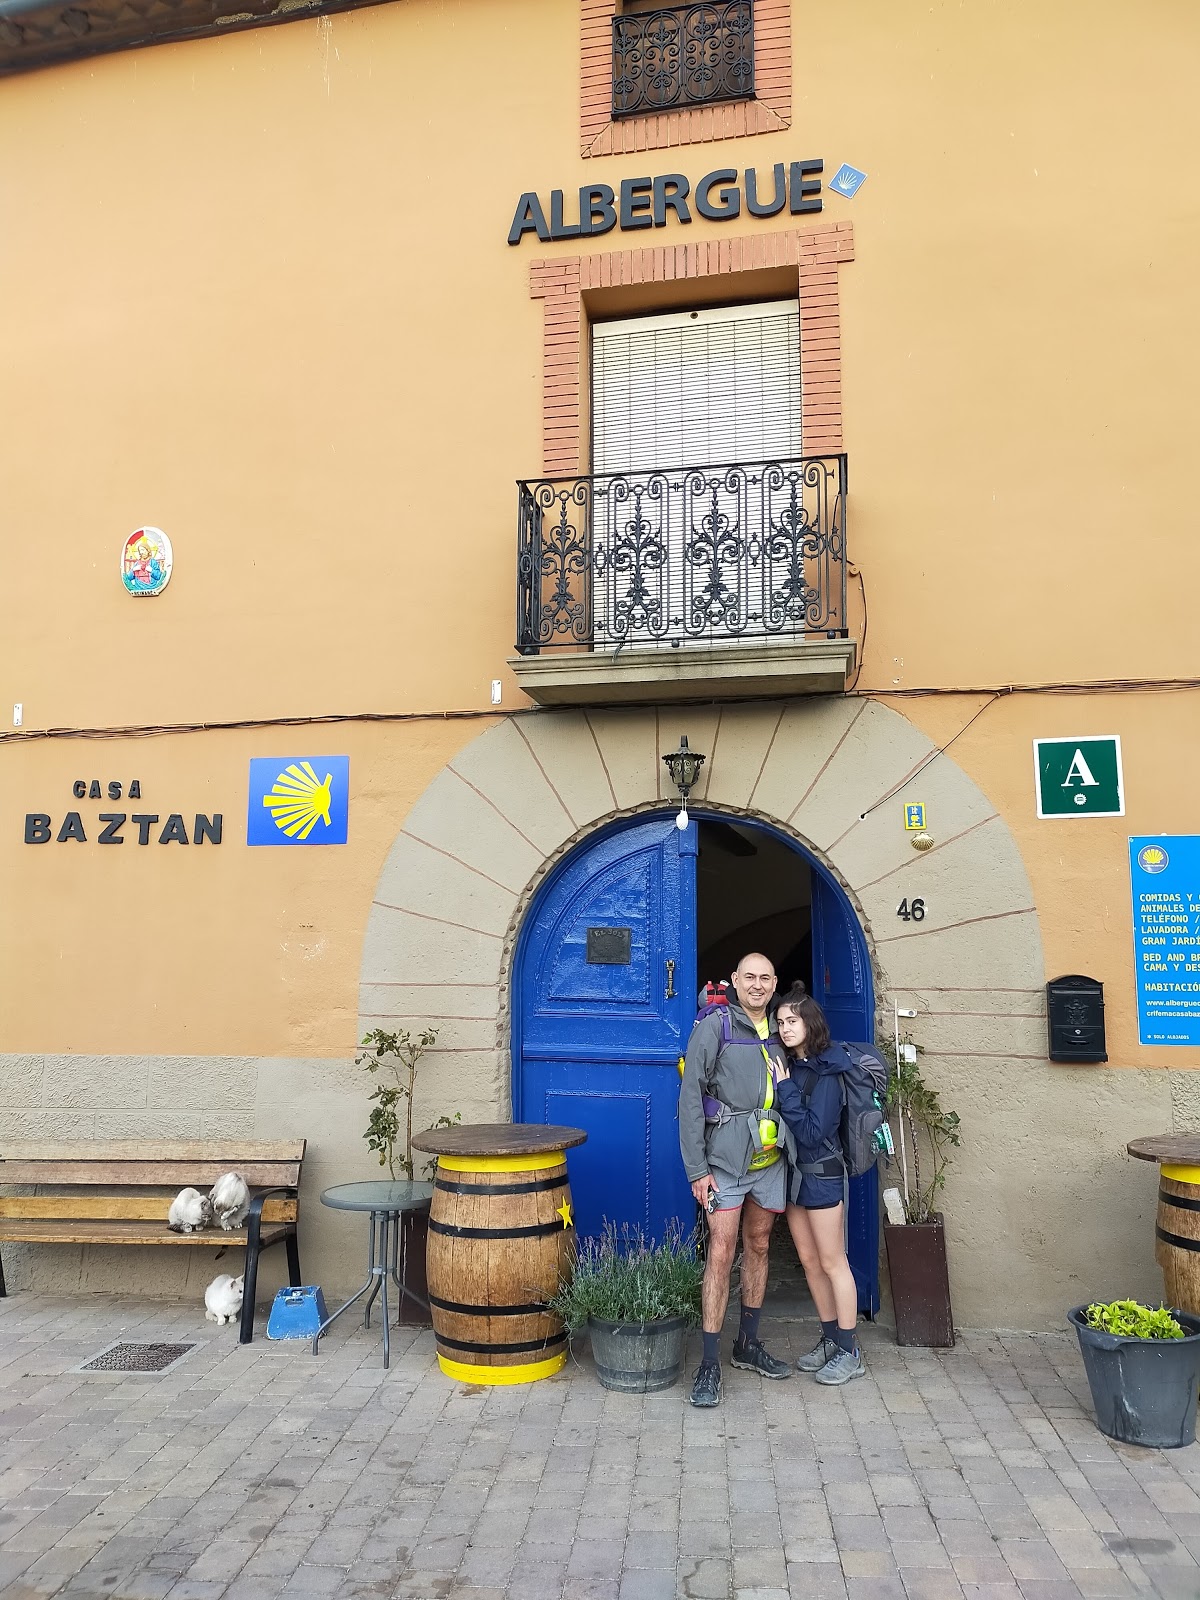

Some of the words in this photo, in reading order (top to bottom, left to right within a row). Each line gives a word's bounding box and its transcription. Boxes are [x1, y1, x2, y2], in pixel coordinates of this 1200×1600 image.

[507, 158, 824, 246] ALBERGUE
[1061, 748, 1100, 787] A
[73, 779, 141, 800] CASA
[24, 811, 223, 845] BAZTAN
[1140, 894, 1181, 902] COMIDAS
[1186, 894, 1193, 902] Y
[897, 898, 925, 921] 46
[1140, 904, 1184, 912] ANIMALES
[1140, 913, 1189, 923] TELÉFONO
[1141, 925, 1189, 934] LAVADORA
[1142, 937, 1166, 945] GRAN
[1143, 953, 1161, 962] BED
[1167, 953, 1185, 962] AND
[1144, 963, 1168, 972] CAMA
[1173, 963, 1180, 972] Y
[1145, 982, 1200, 992] HABITACIÓ
